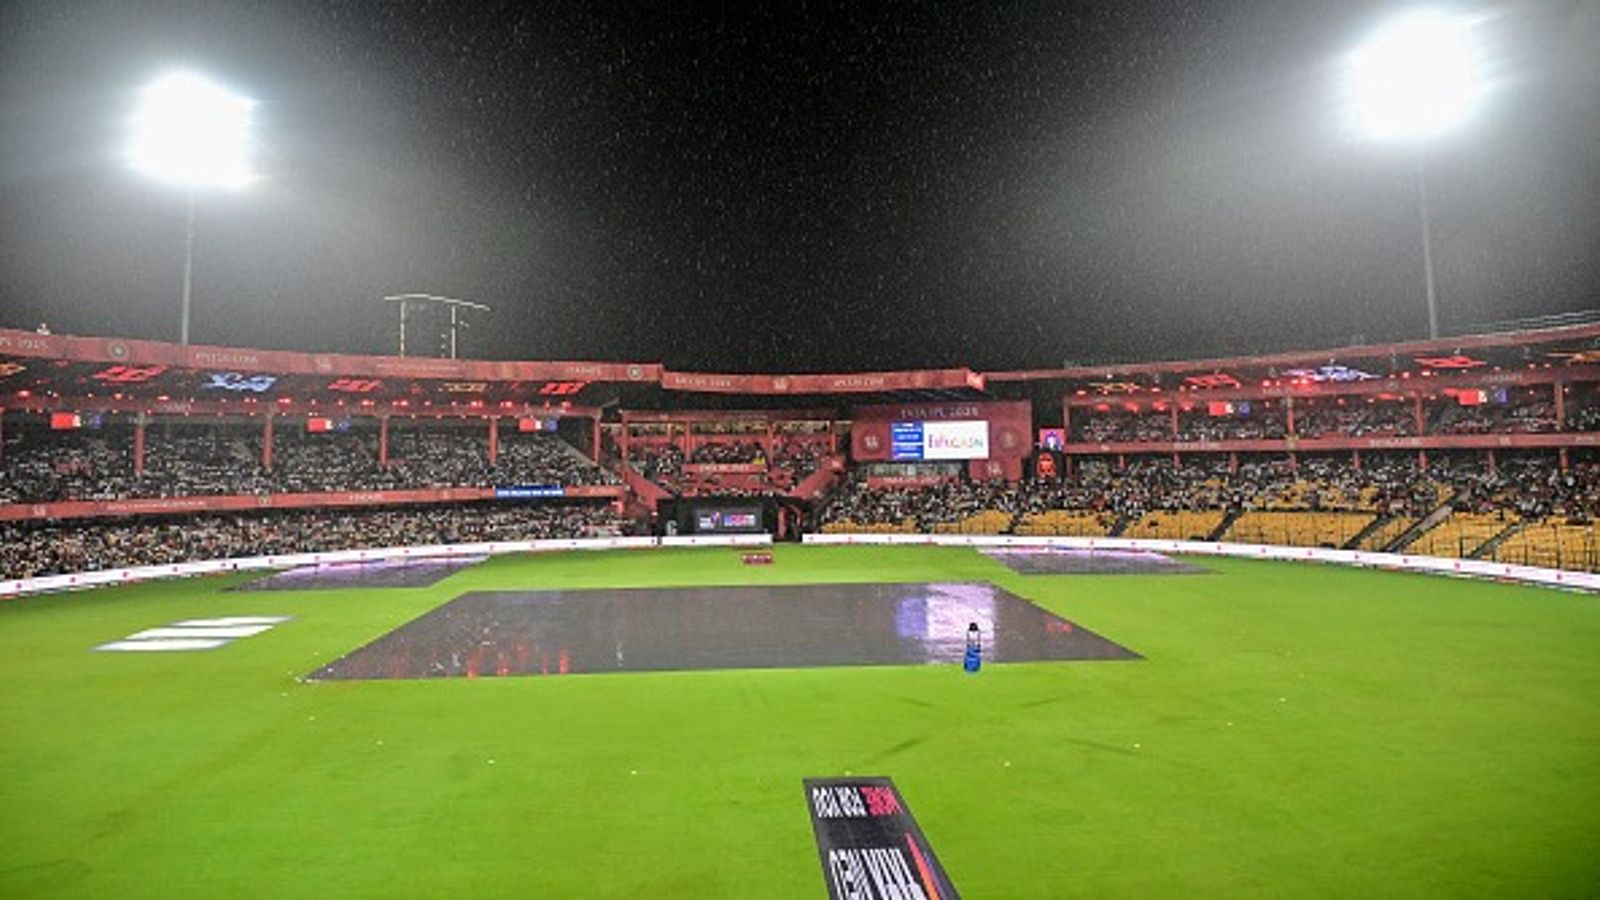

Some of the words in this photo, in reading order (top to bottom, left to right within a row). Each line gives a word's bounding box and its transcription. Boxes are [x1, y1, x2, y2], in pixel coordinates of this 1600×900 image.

[949, 407, 979, 417] 2025
[812, 786, 843, 818] YOU
[835, 786, 867, 817] FOR
